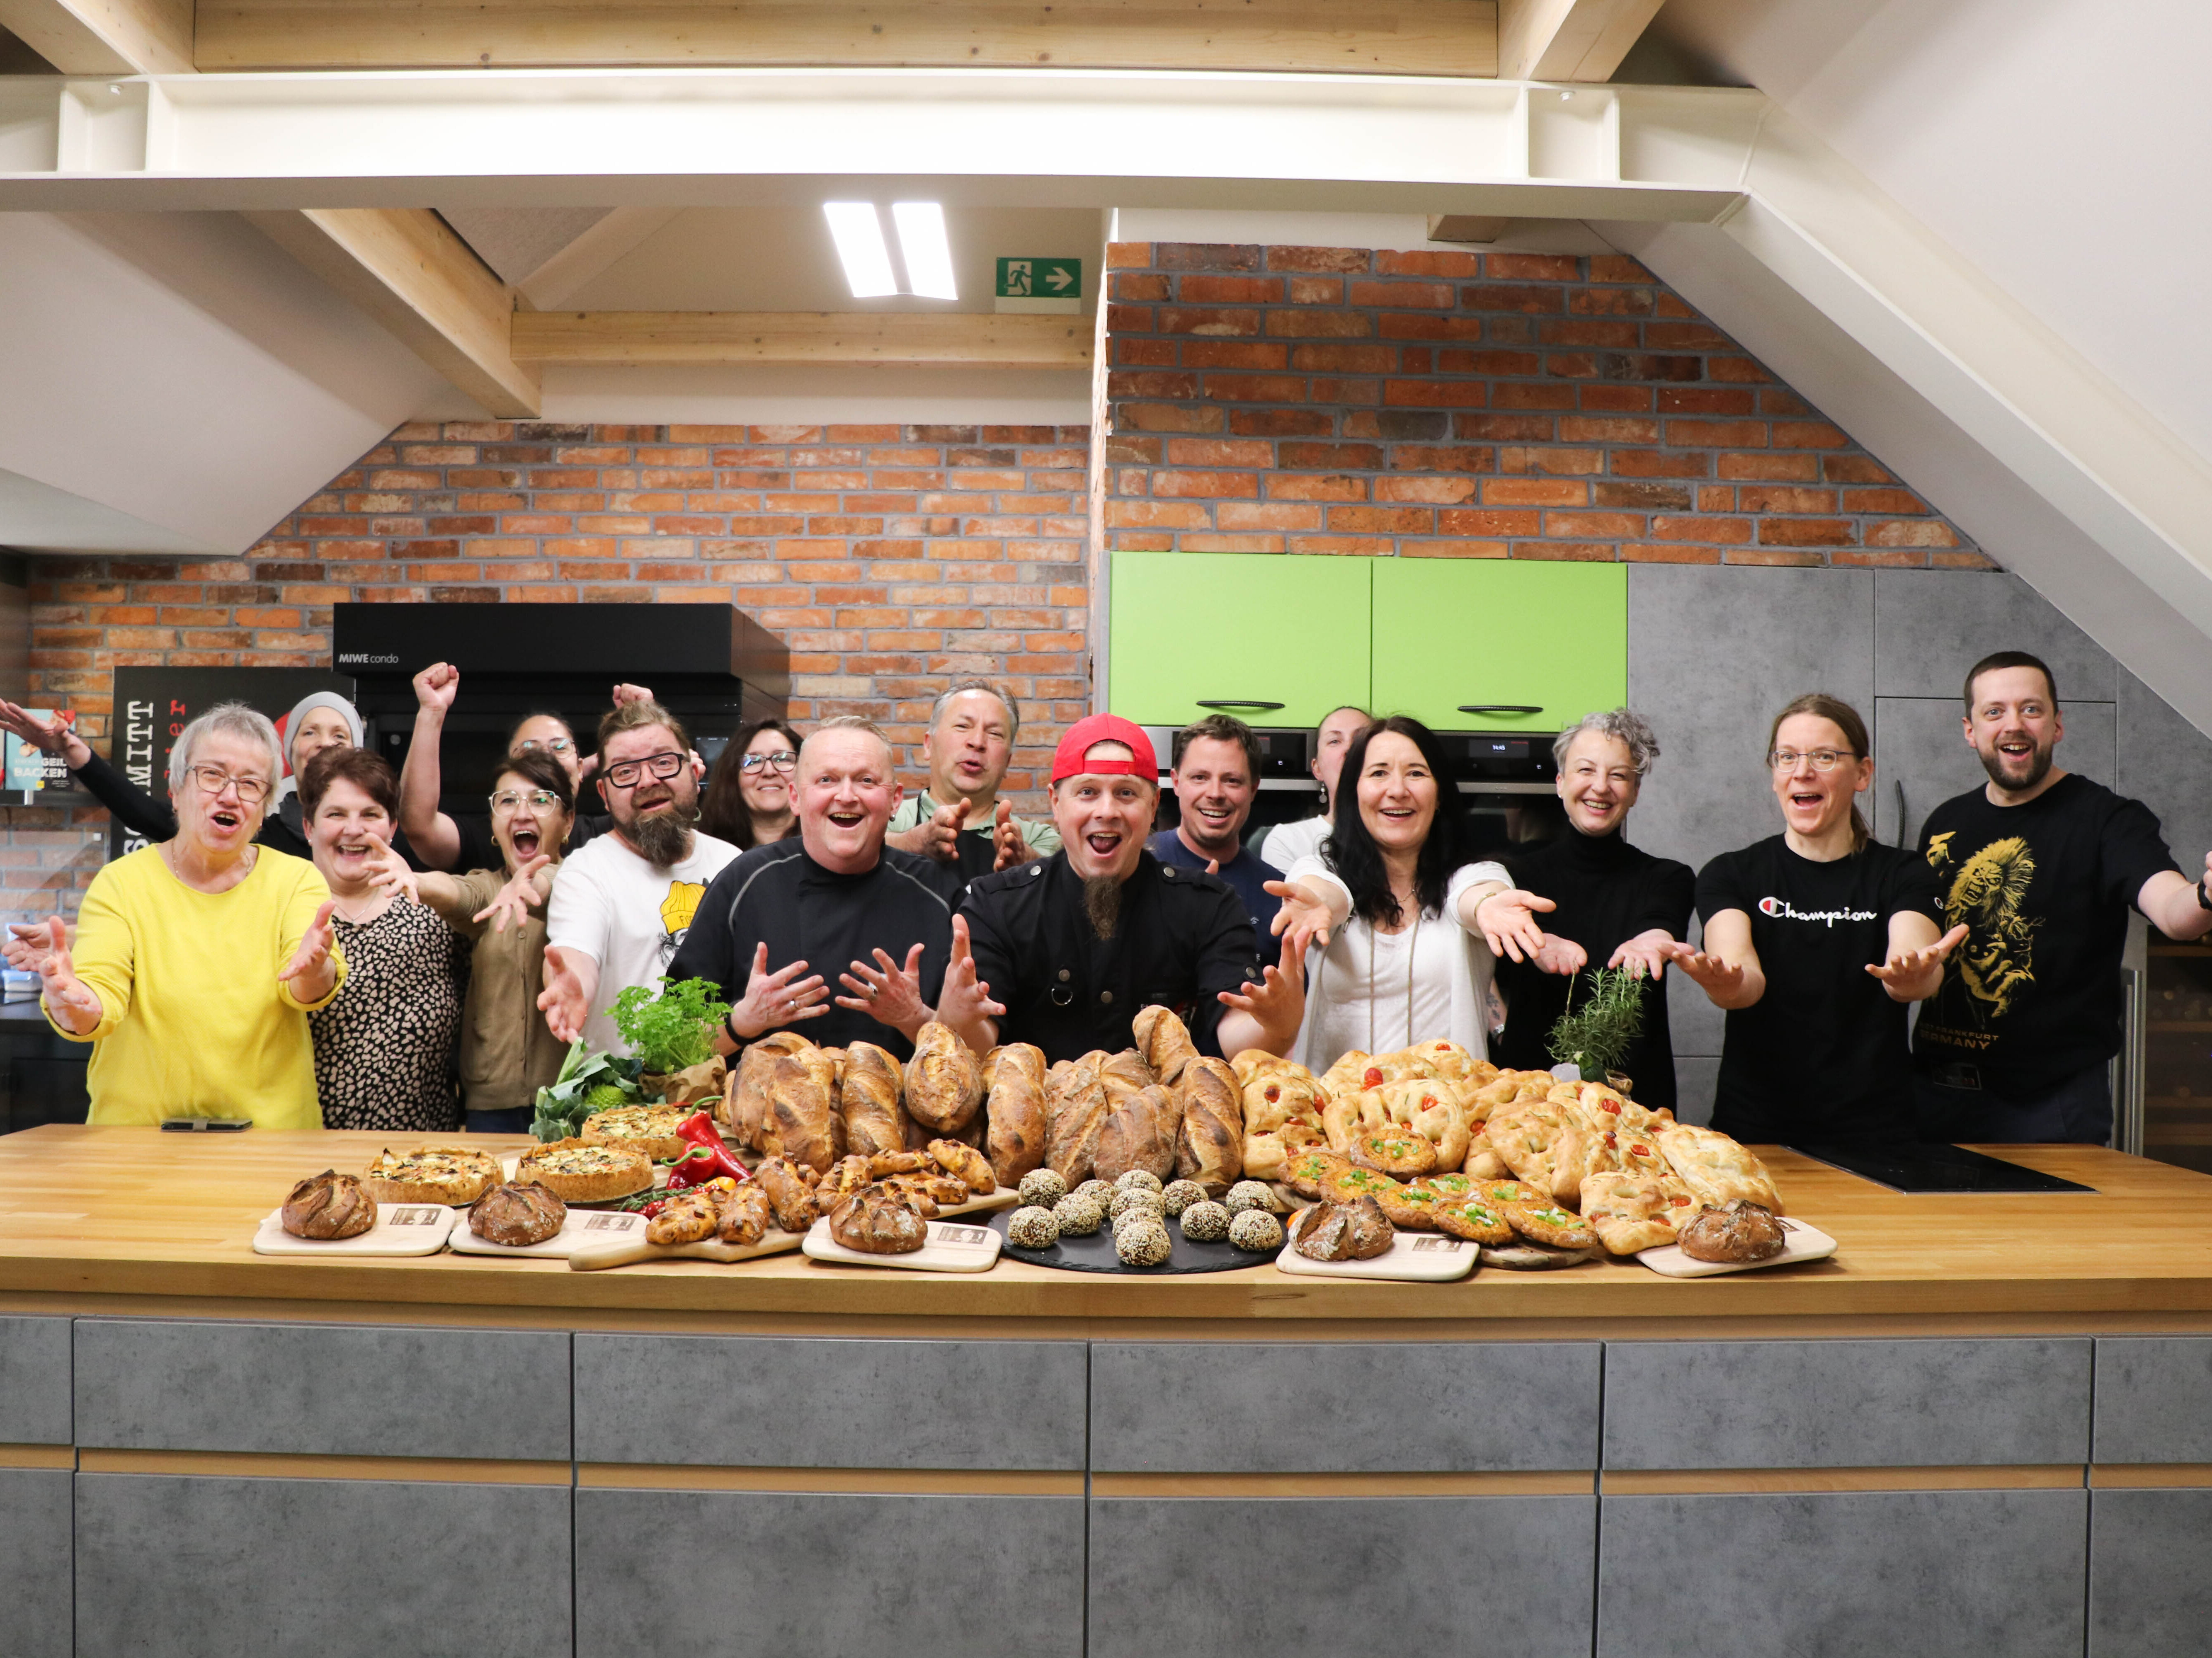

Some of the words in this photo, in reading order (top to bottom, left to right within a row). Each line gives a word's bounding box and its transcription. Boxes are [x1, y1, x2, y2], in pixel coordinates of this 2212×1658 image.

[339, 654, 369, 663] MIWE
[370, 653, 399, 663] condo
[41, 757, 67, 767] GEIL
[14, 767, 67, 778] BACKEN
[123, 701, 154, 856] SMITT
[1758, 897, 1877, 928] Champion
